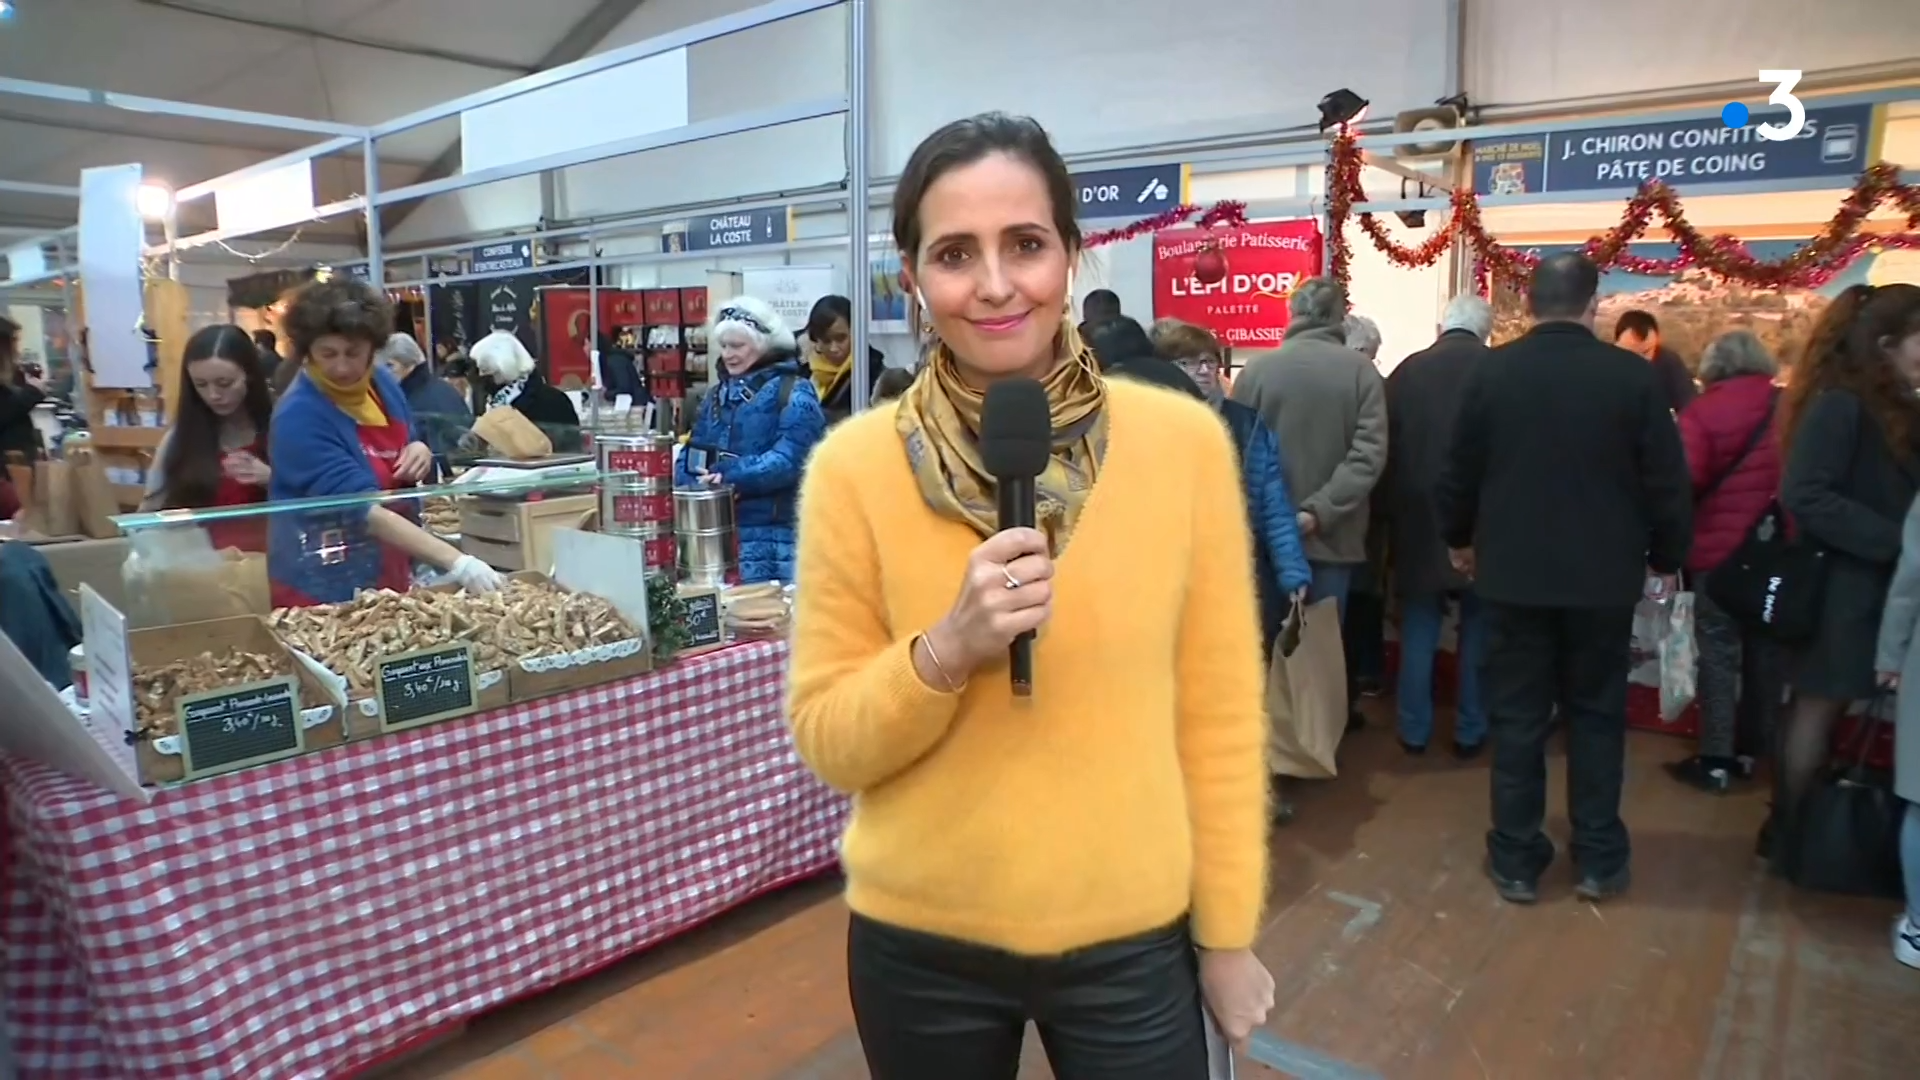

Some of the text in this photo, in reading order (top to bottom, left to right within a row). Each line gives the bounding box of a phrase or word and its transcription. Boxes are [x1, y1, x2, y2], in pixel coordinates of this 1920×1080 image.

[1561, 139, 1576, 160] J.
[1581, 133, 1664, 155] CHIRON
[1596, 152, 1766, 180] PÂTE DE COING
[1082, 185, 1120, 203] D'OR
[709, 215, 752, 231] CHÂTEAU
[709, 230, 752, 246] LA COSTE
[1232, 271, 1294, 294] D'OR
[1207, 303, 1260, 315] PALETTE
[1226, 327, 1287, 341] GIBASSIE
